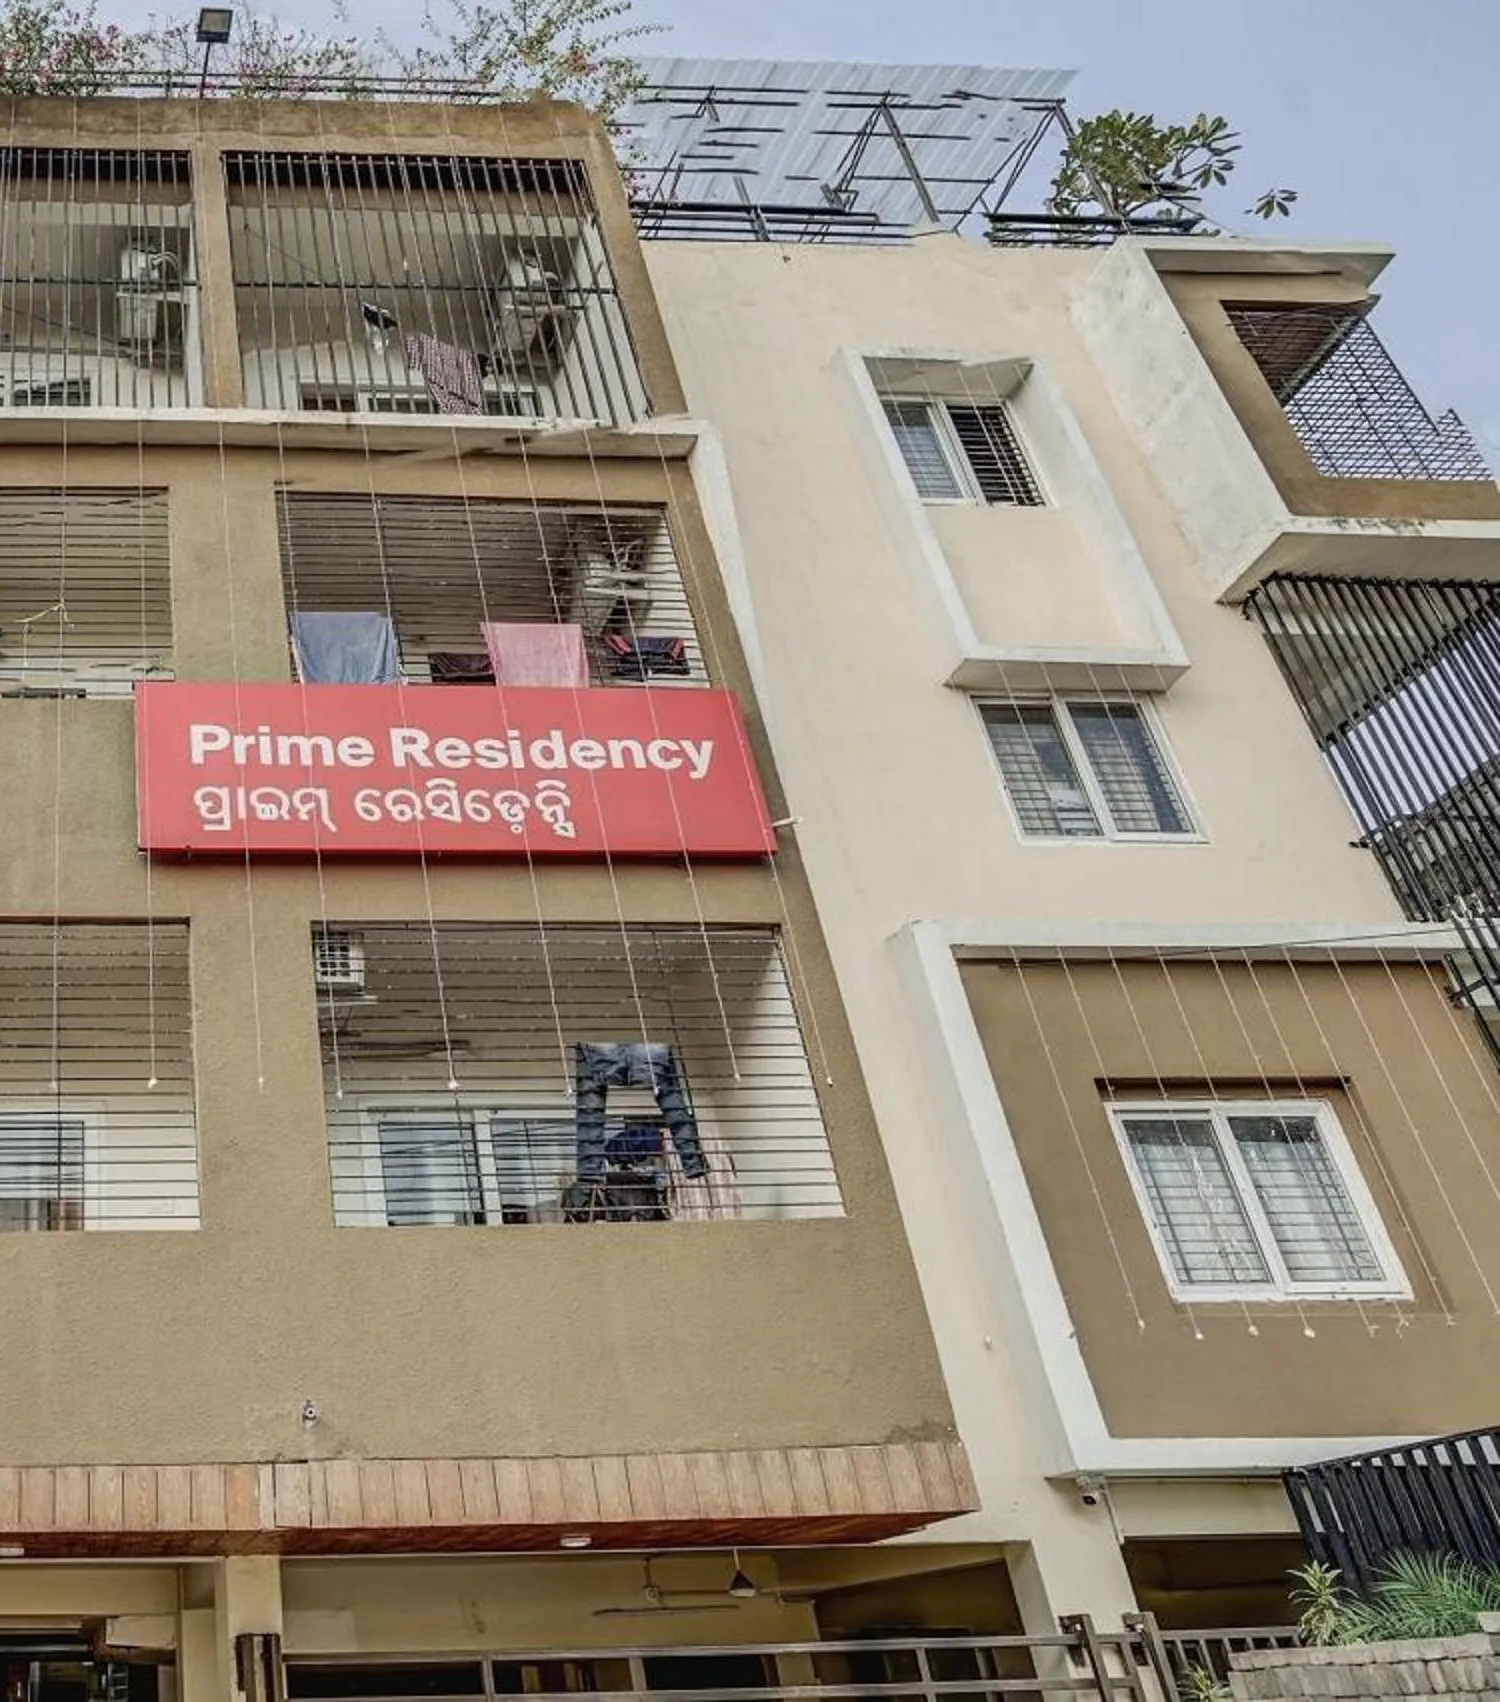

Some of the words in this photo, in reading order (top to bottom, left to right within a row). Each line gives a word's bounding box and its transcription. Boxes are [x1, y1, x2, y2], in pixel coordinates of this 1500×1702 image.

[188, 723, 376, 768] Prime
[388, 727, 714, 780] Residency
[193, 785, 338, 832] ପ୍ରାଇମ୍
